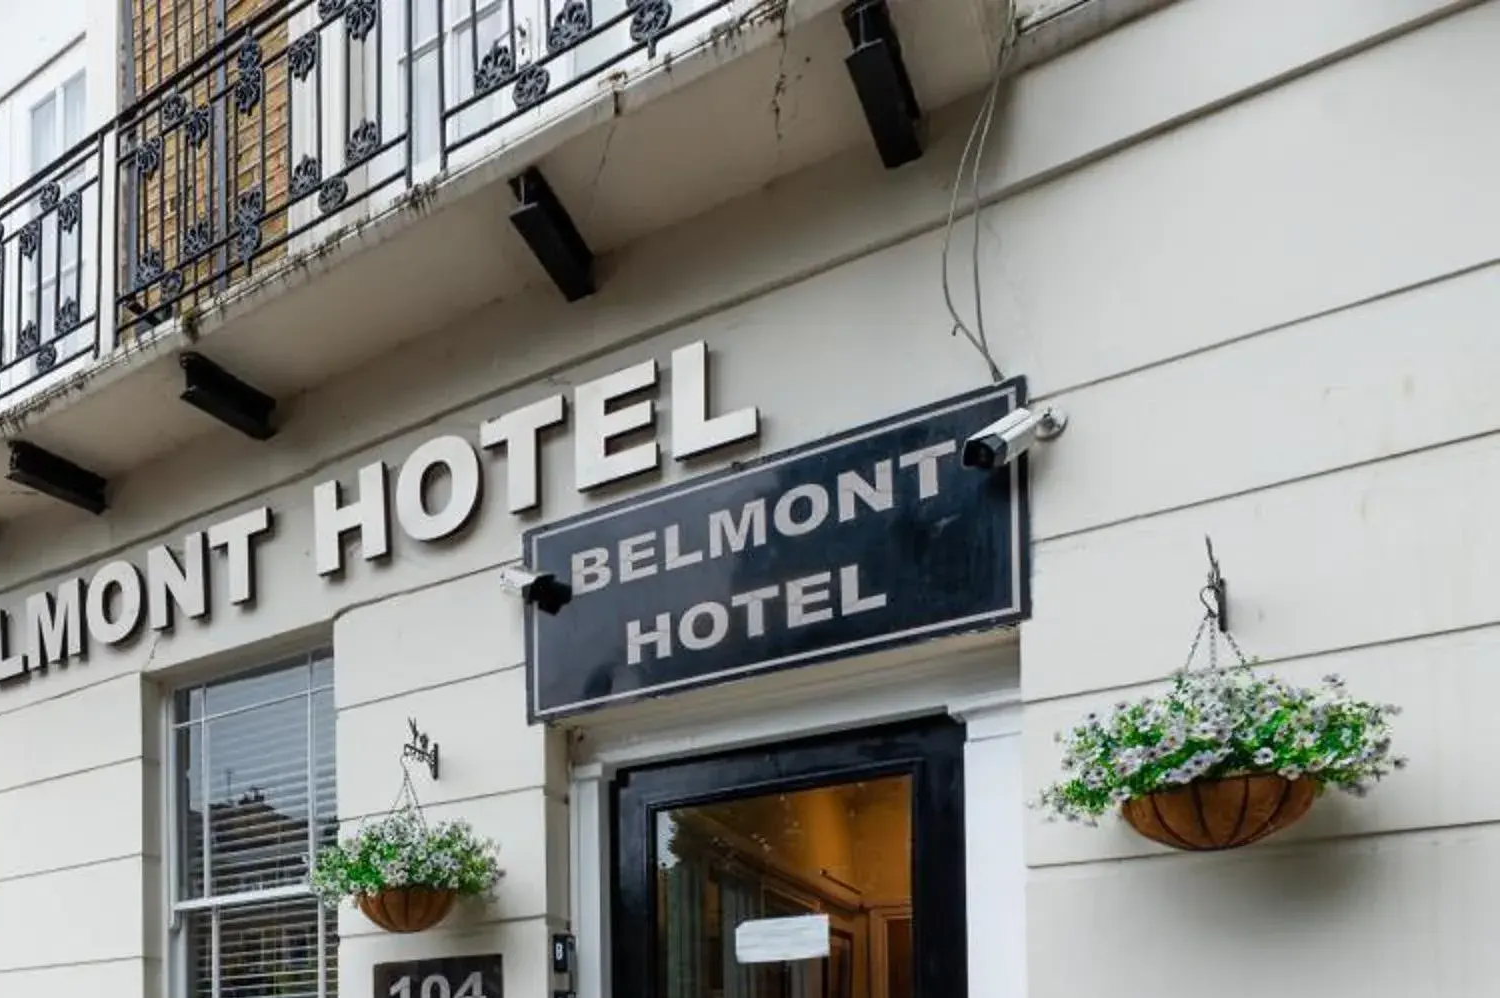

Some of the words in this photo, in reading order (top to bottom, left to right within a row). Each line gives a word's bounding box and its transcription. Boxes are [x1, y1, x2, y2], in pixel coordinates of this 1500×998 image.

[312, 339, 760, 577] HOTEL
[571, 439, 958, 597] BELMONT
[626, 563, 888, 666] HOTEL
